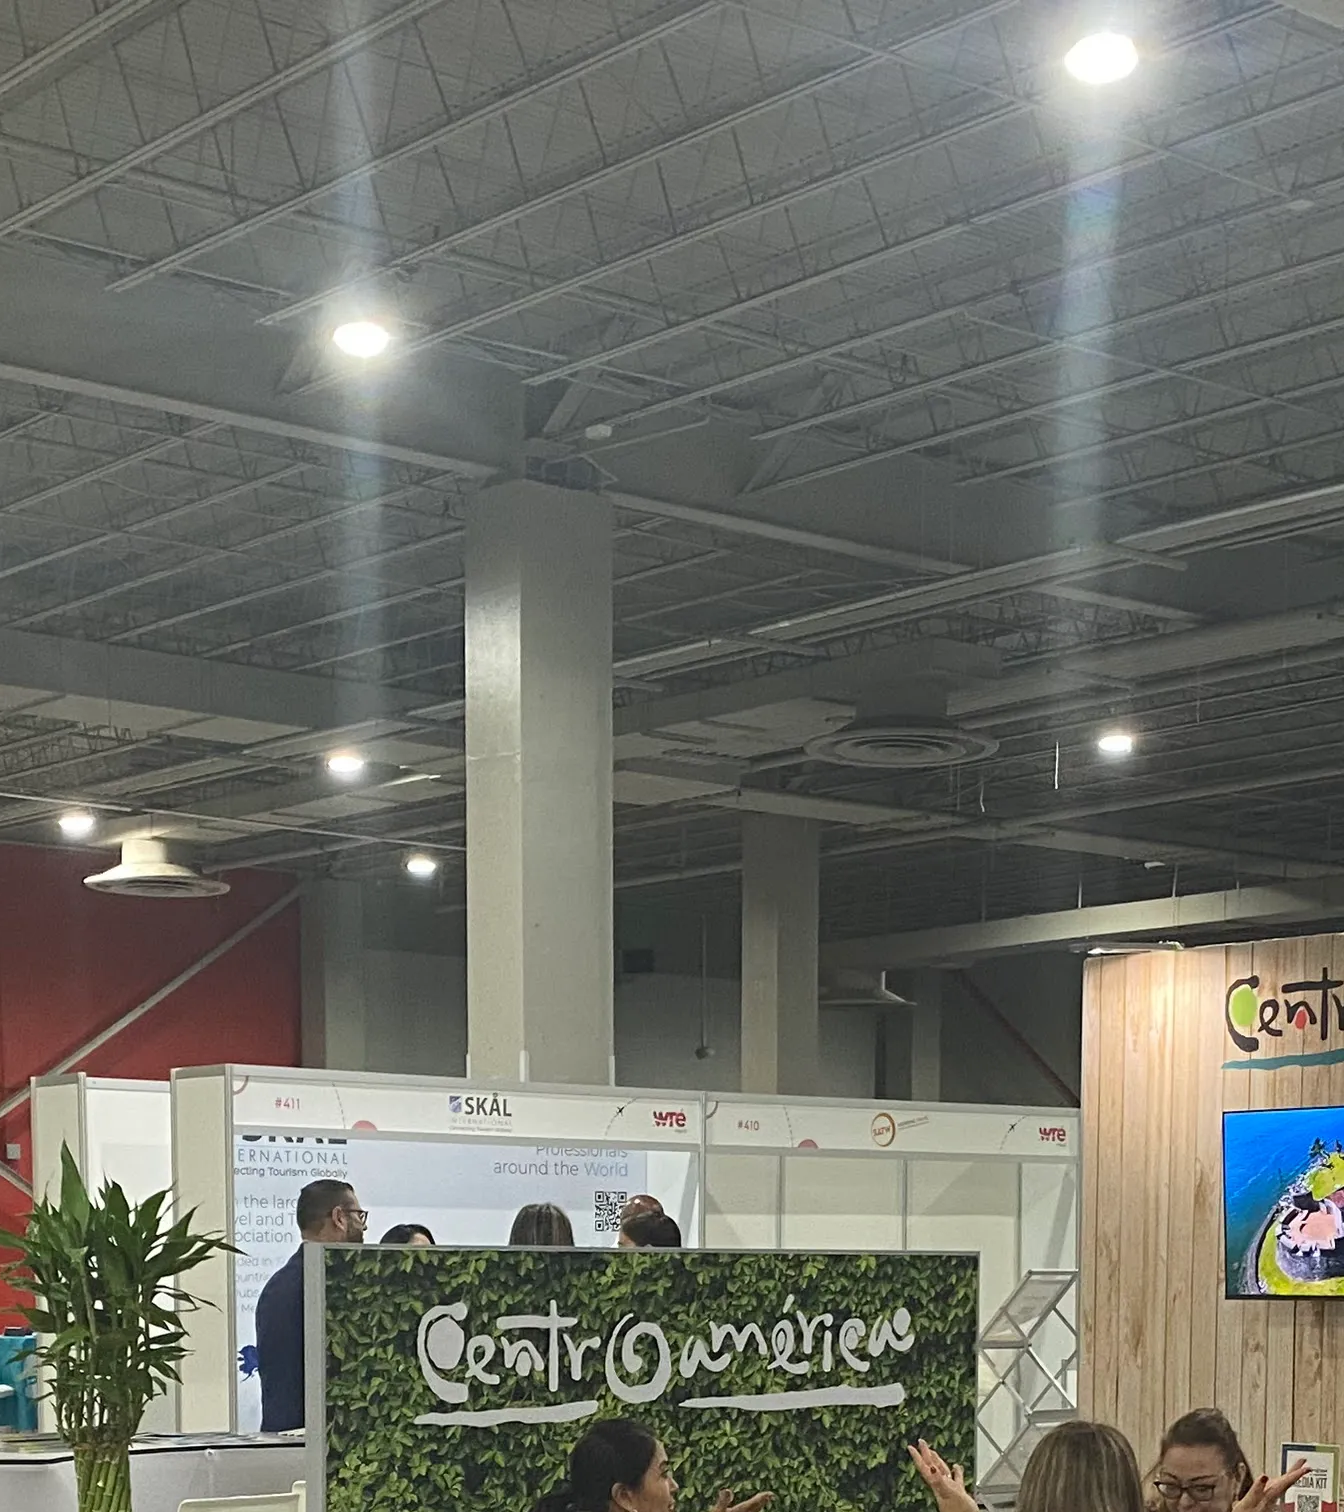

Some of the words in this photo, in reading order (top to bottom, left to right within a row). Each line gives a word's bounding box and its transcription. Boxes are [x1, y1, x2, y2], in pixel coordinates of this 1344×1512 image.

[274, 1097, 301, 1111] #411
[464, 1092, 513, 1118] SKÅL
[268, 1166, 307, 1177] Tourism
[311, 1168, 348, 1179] Globally
[493, 1160, 548, 1175] around
[554, 1161, 579, 1176] the
[584, 1162, 628, 1177] World
[244, 1194, 268, 1209] the
[256, 1213, 284, 1226] and
[417, 1295, 914, 1402] Centroamérica
